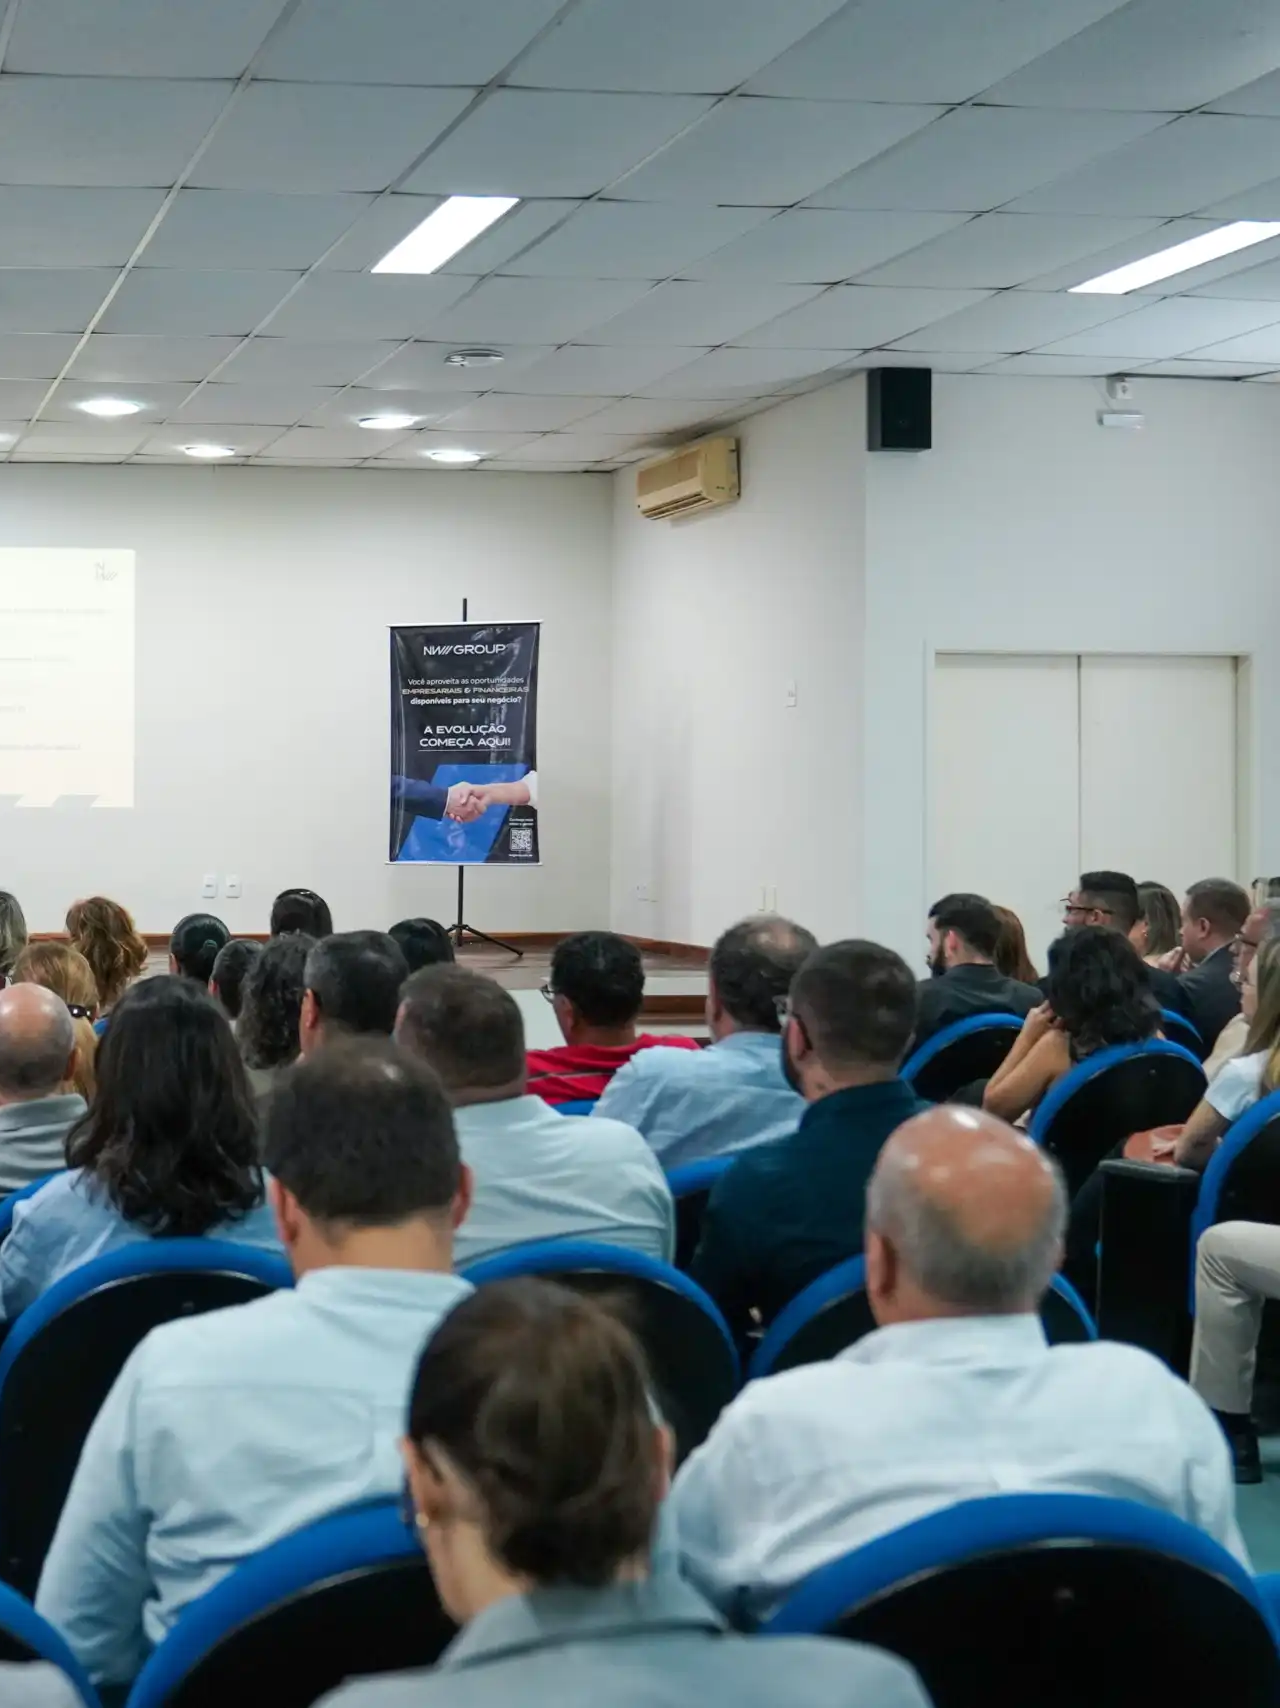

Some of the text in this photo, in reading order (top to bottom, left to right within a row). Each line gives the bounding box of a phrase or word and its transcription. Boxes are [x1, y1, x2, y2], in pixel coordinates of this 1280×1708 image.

[470, 677, 524, 685] oportunidades
[410, 698, 452, 706] disponíveis
[453, 698, 470, 706] para
[487, 697, 522, 705] negócio?
[424, 723, 506, 735] A EVOLUÇÃO
[420, 737, 511, 748] COMEÇA AQUI!
